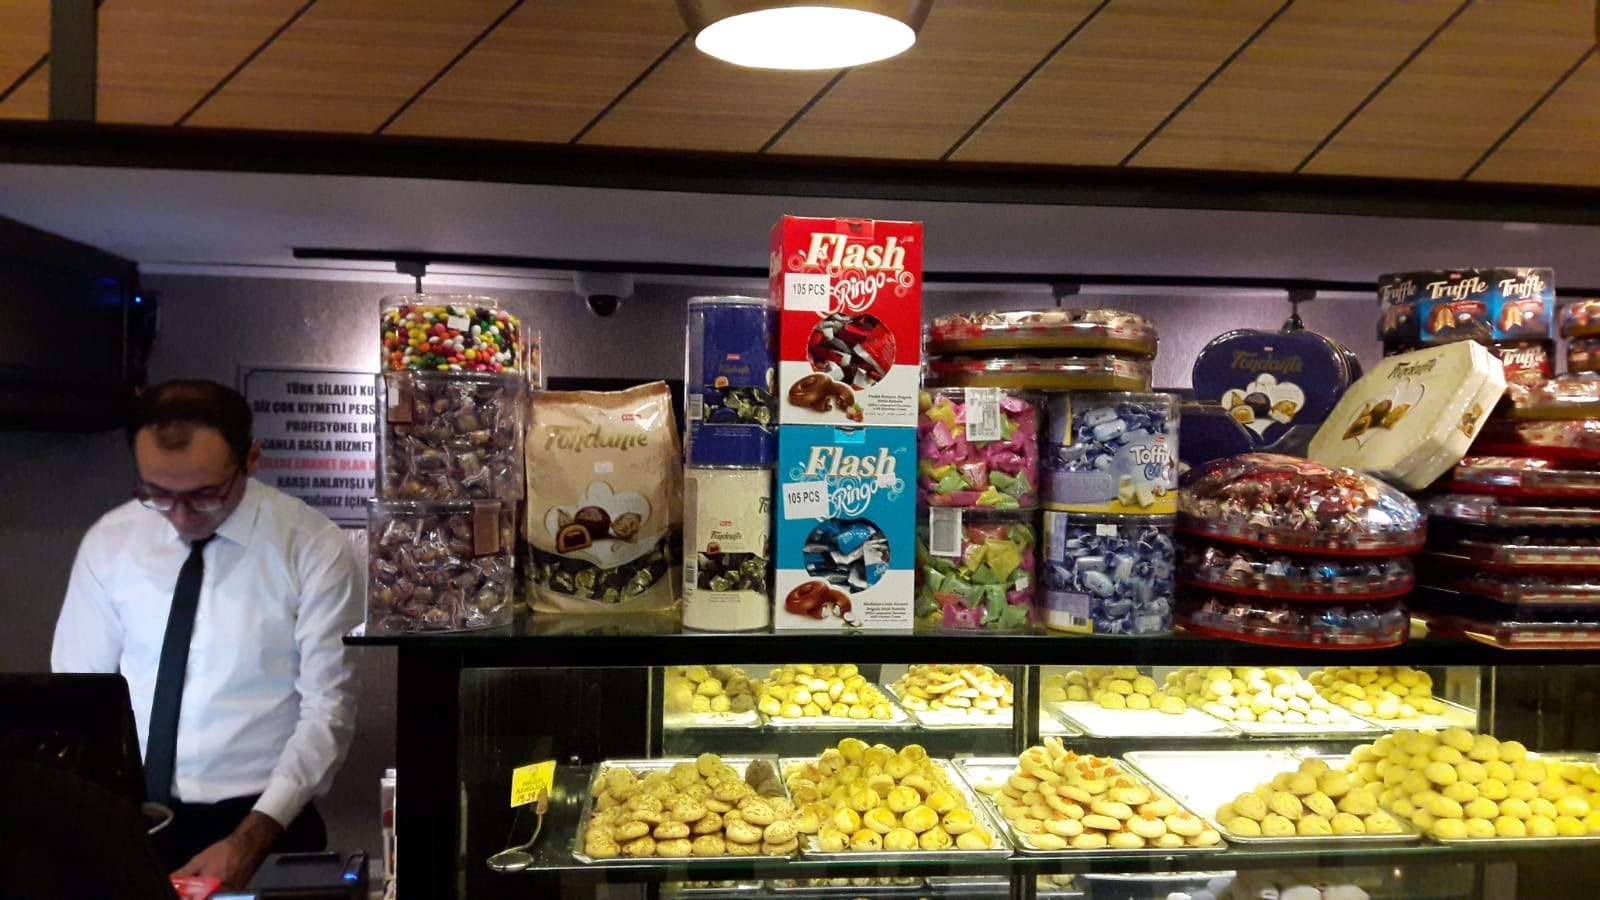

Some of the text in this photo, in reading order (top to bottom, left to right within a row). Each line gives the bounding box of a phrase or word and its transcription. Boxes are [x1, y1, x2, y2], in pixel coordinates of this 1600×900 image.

[803, 232, 906, 270] Flash
[793, 283, 826, 296] 105 PCS
[830, 271, 885, 312] Ringo
[1380, 280, 1417, 302] Truffle
[1426, 277, 1488, 300] Truffle
[1499, 274, 1547, 299] Truffle
[286, 382, 314, 396] TÜRK
[316, 383, 357, 396] SİLAHLI
[298, 401, 346, 414] KIYMETLİ
[286, 421, 358, 434] PROFESYONEL
[298, 439, 332, 453] BAŞLA
[335, 440, 373, 453] HİZMET
[803, 446, 897, 478] Flash
[312, 477, 365, 490] ANLAYIŞLI
[788, 490, 820, 504] 105 PCS
[832, 479, 878, 517] Ringo
